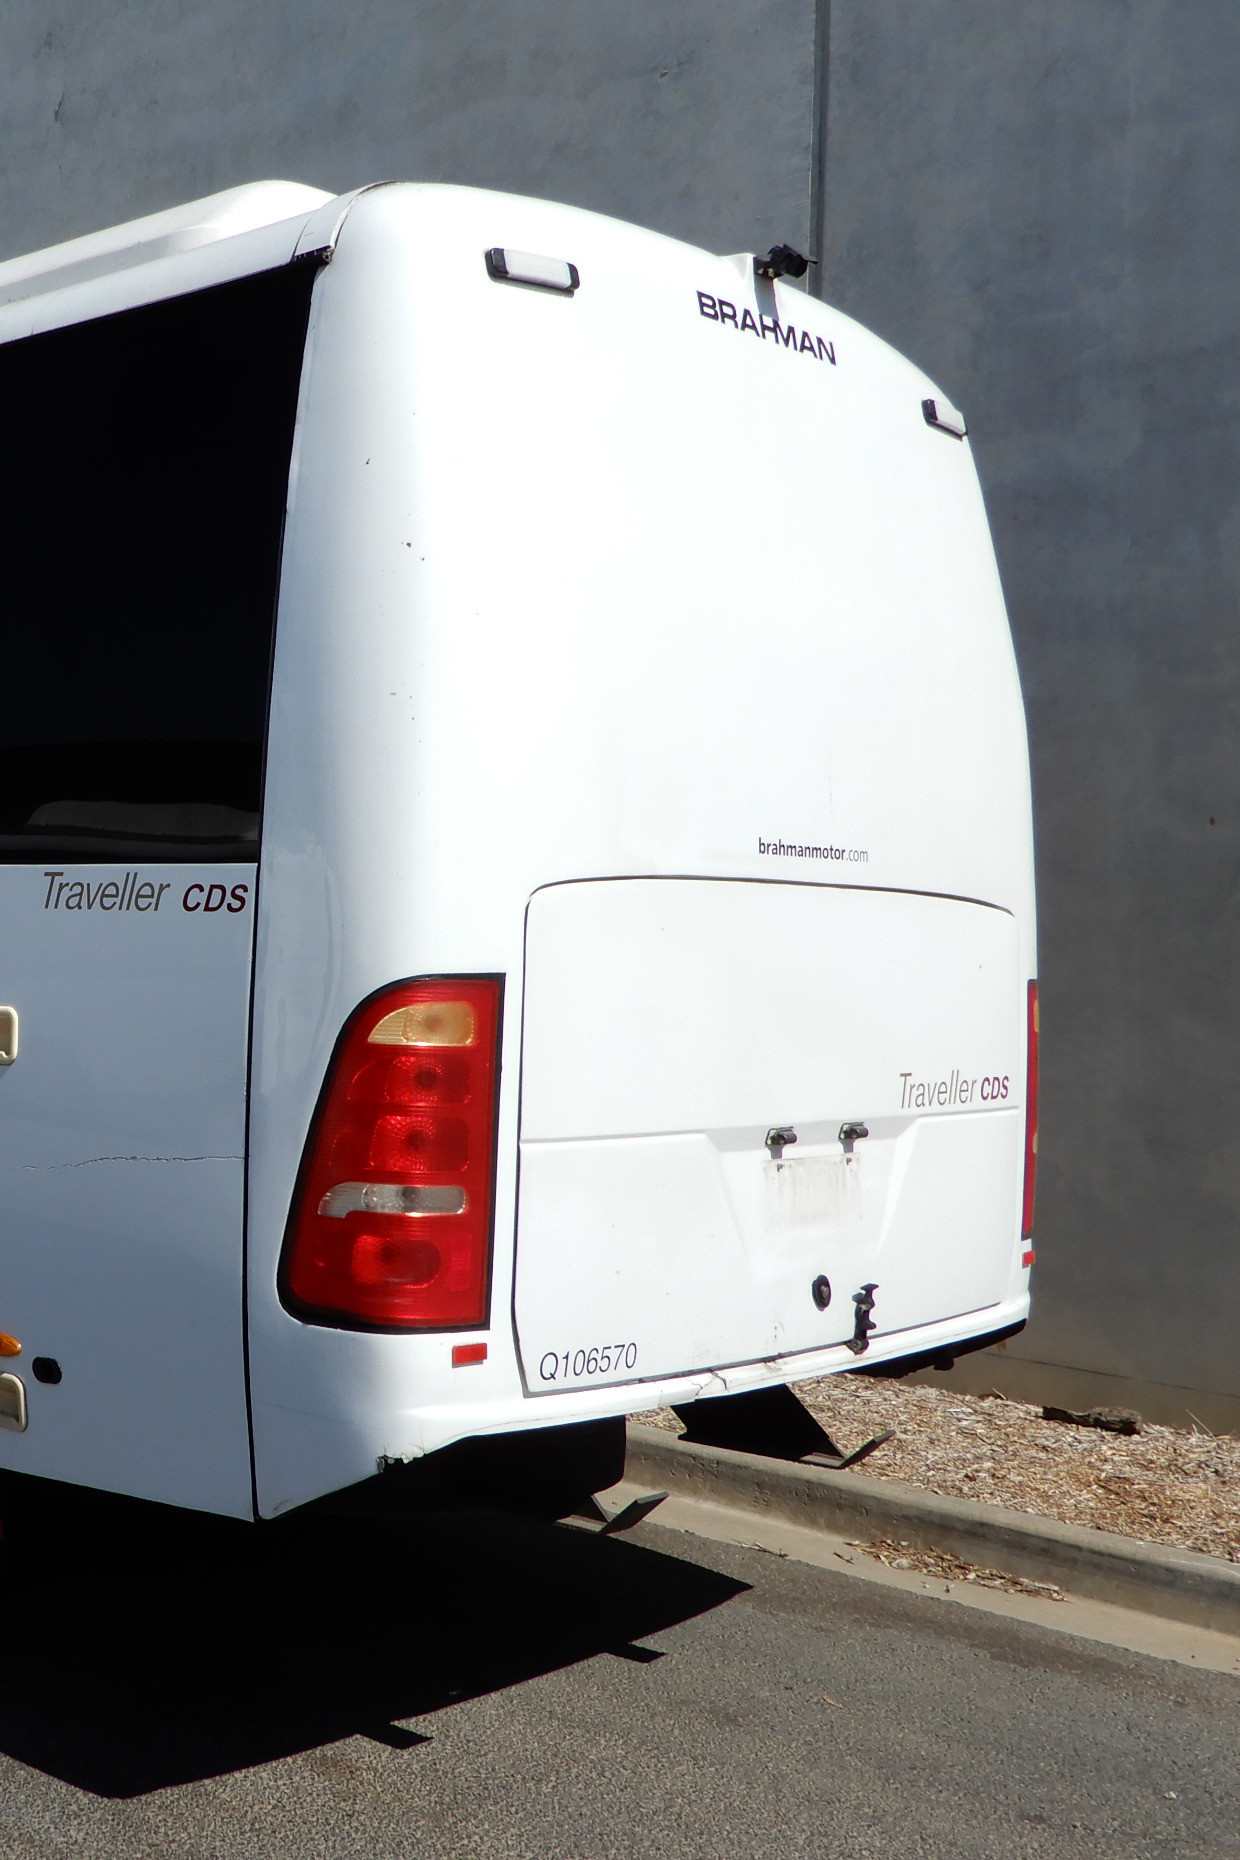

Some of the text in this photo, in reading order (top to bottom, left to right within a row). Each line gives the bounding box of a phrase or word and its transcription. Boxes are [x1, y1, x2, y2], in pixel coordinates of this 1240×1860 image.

[695, 290, 837, 367] BRAHMAN
[758, 836, 869, 863] brahmanmotor.com
[43, 871, 249, 914] Traveller CDS
[899, 1069, 1010, 1109] Traveller CDS
[539, 1342, 638, 1381] Q106570
